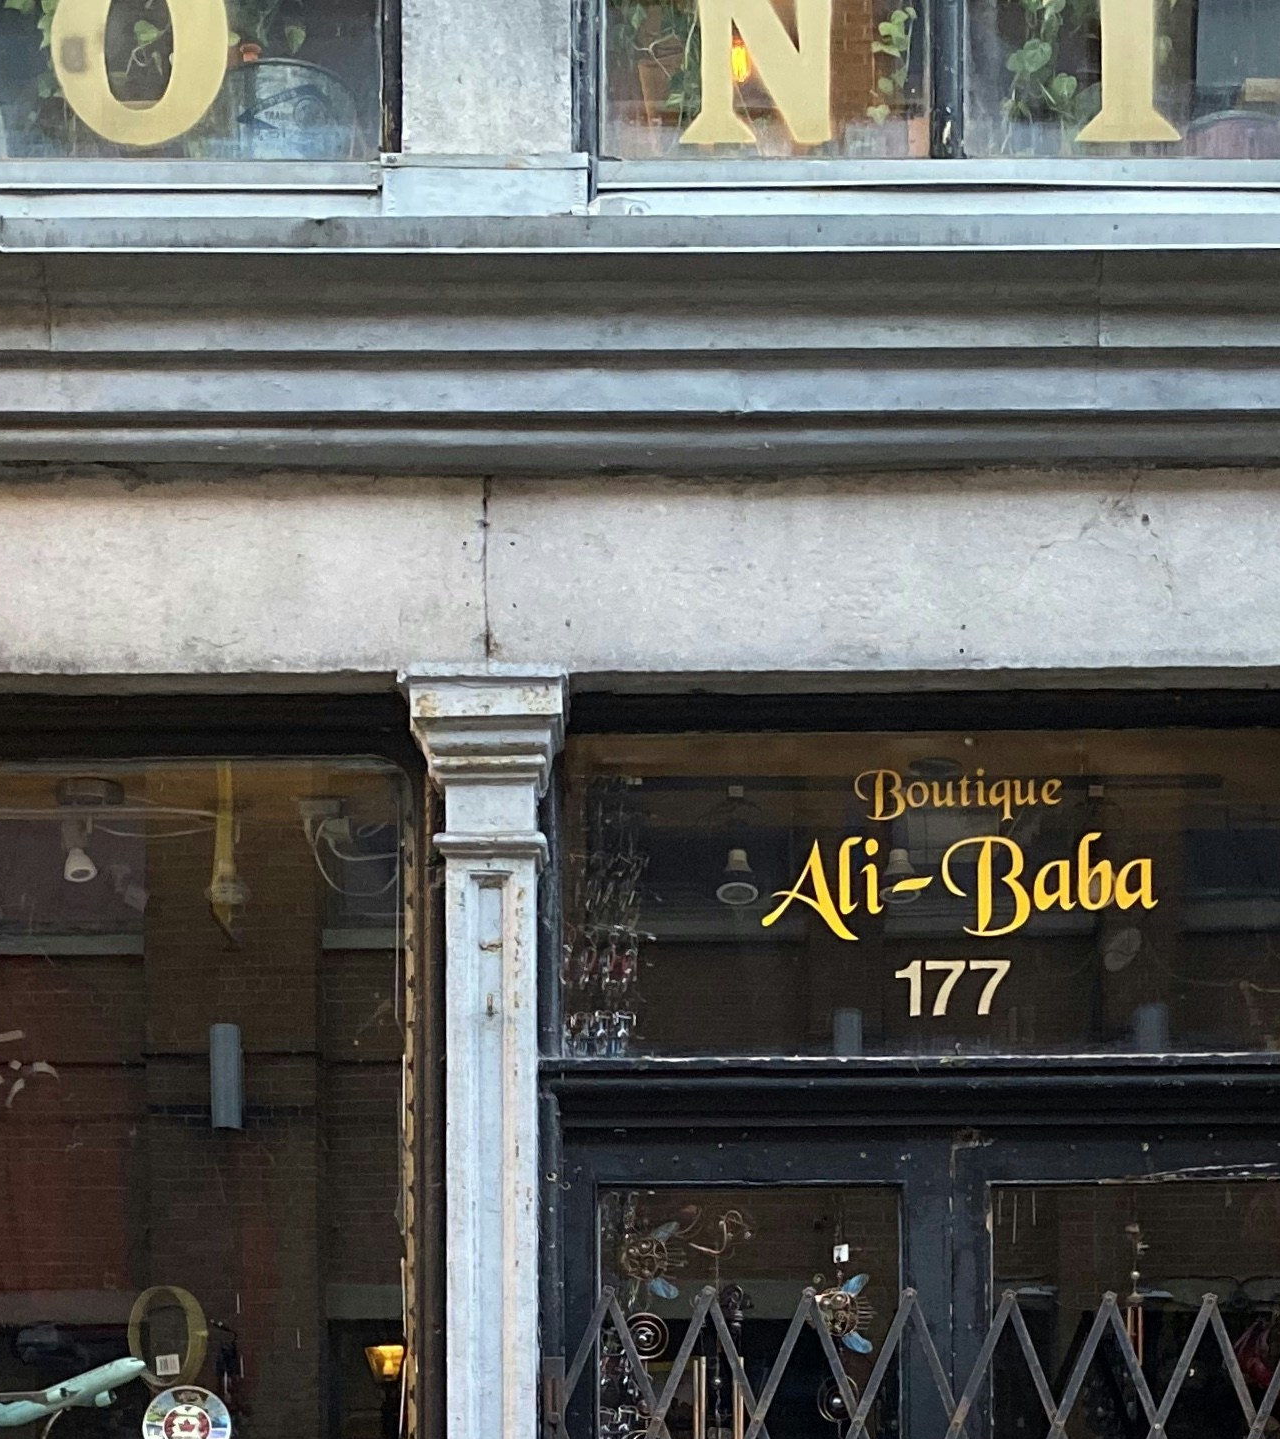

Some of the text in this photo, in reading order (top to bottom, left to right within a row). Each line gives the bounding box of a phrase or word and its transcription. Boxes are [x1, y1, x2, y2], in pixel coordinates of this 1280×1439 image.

[853, 769, 1062, 821] Boutique
[761, 832, 1158, 940] Ali-Baba
[895, 959, 1011, 1016] 177
